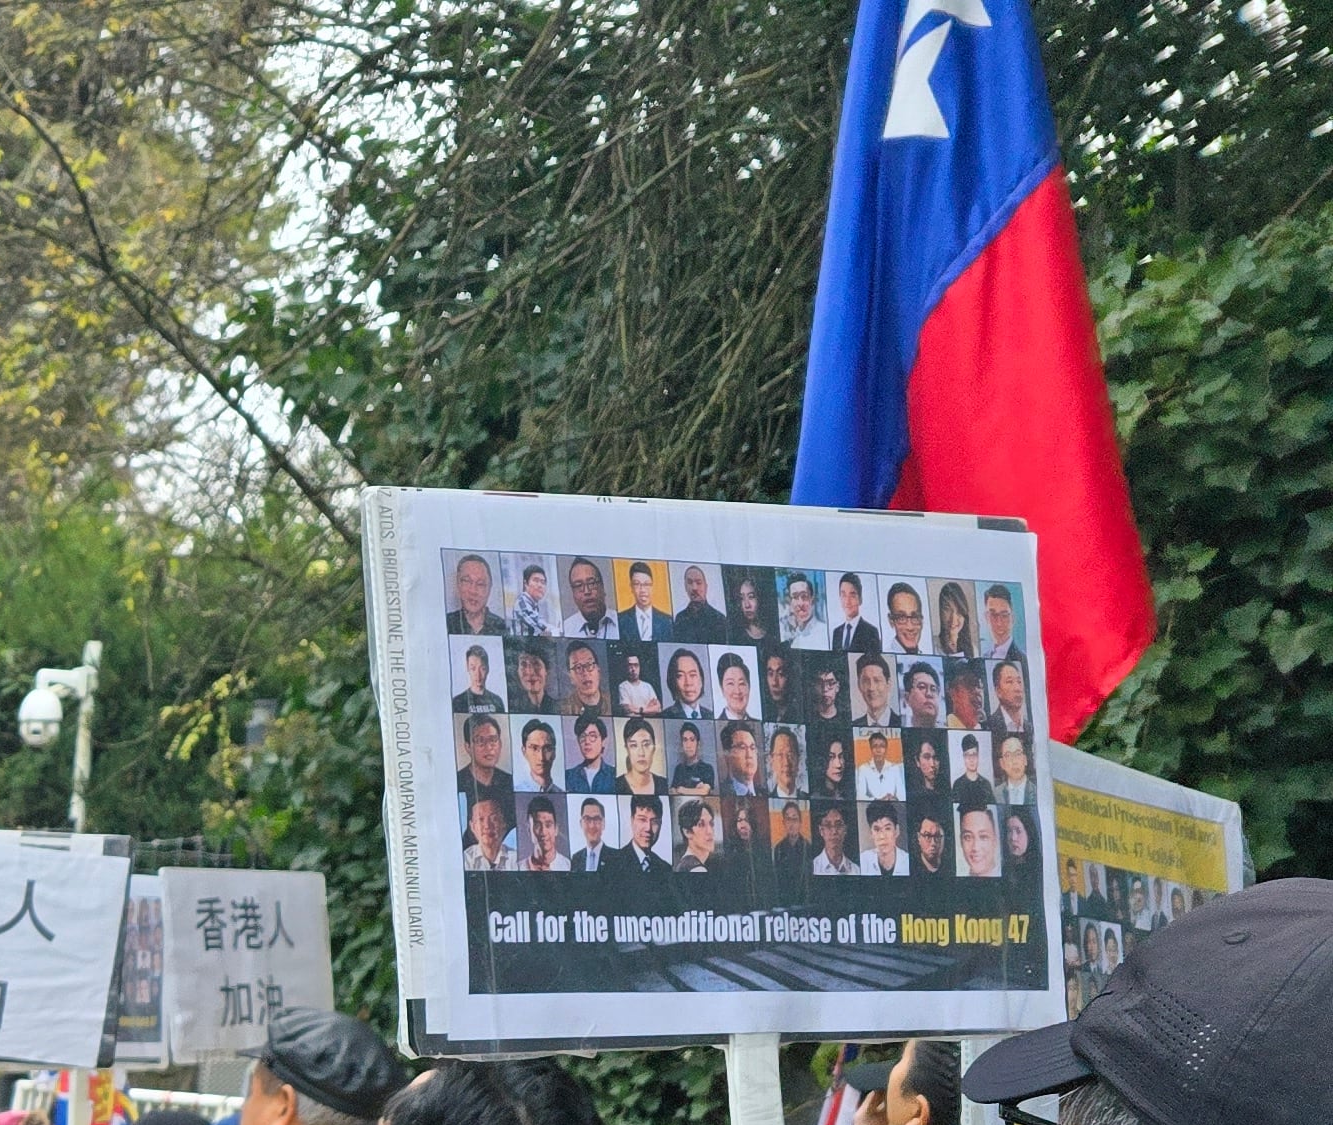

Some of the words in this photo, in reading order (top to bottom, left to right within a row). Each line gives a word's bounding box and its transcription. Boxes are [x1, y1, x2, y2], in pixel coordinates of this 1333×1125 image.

[389, 648, 406, 674] THE
[391, 678, 413, 757] COCA-COLA
[196, 896, 295, 951] 香港人
[489, 910, 531, 943] Call
[536, 910, 568, 943] for
[573, 910, 609, 943] the
[614, 910, 761, 943] unconditional
[765, 911, 832, 944] release
[837, 913, 857, 944] of
[861, 913, 897, 944] the
[901, 913, 949, 946] Hong
[955, 913, 1003, 946] Kong
[1007, 913, 1031, 944] 47
